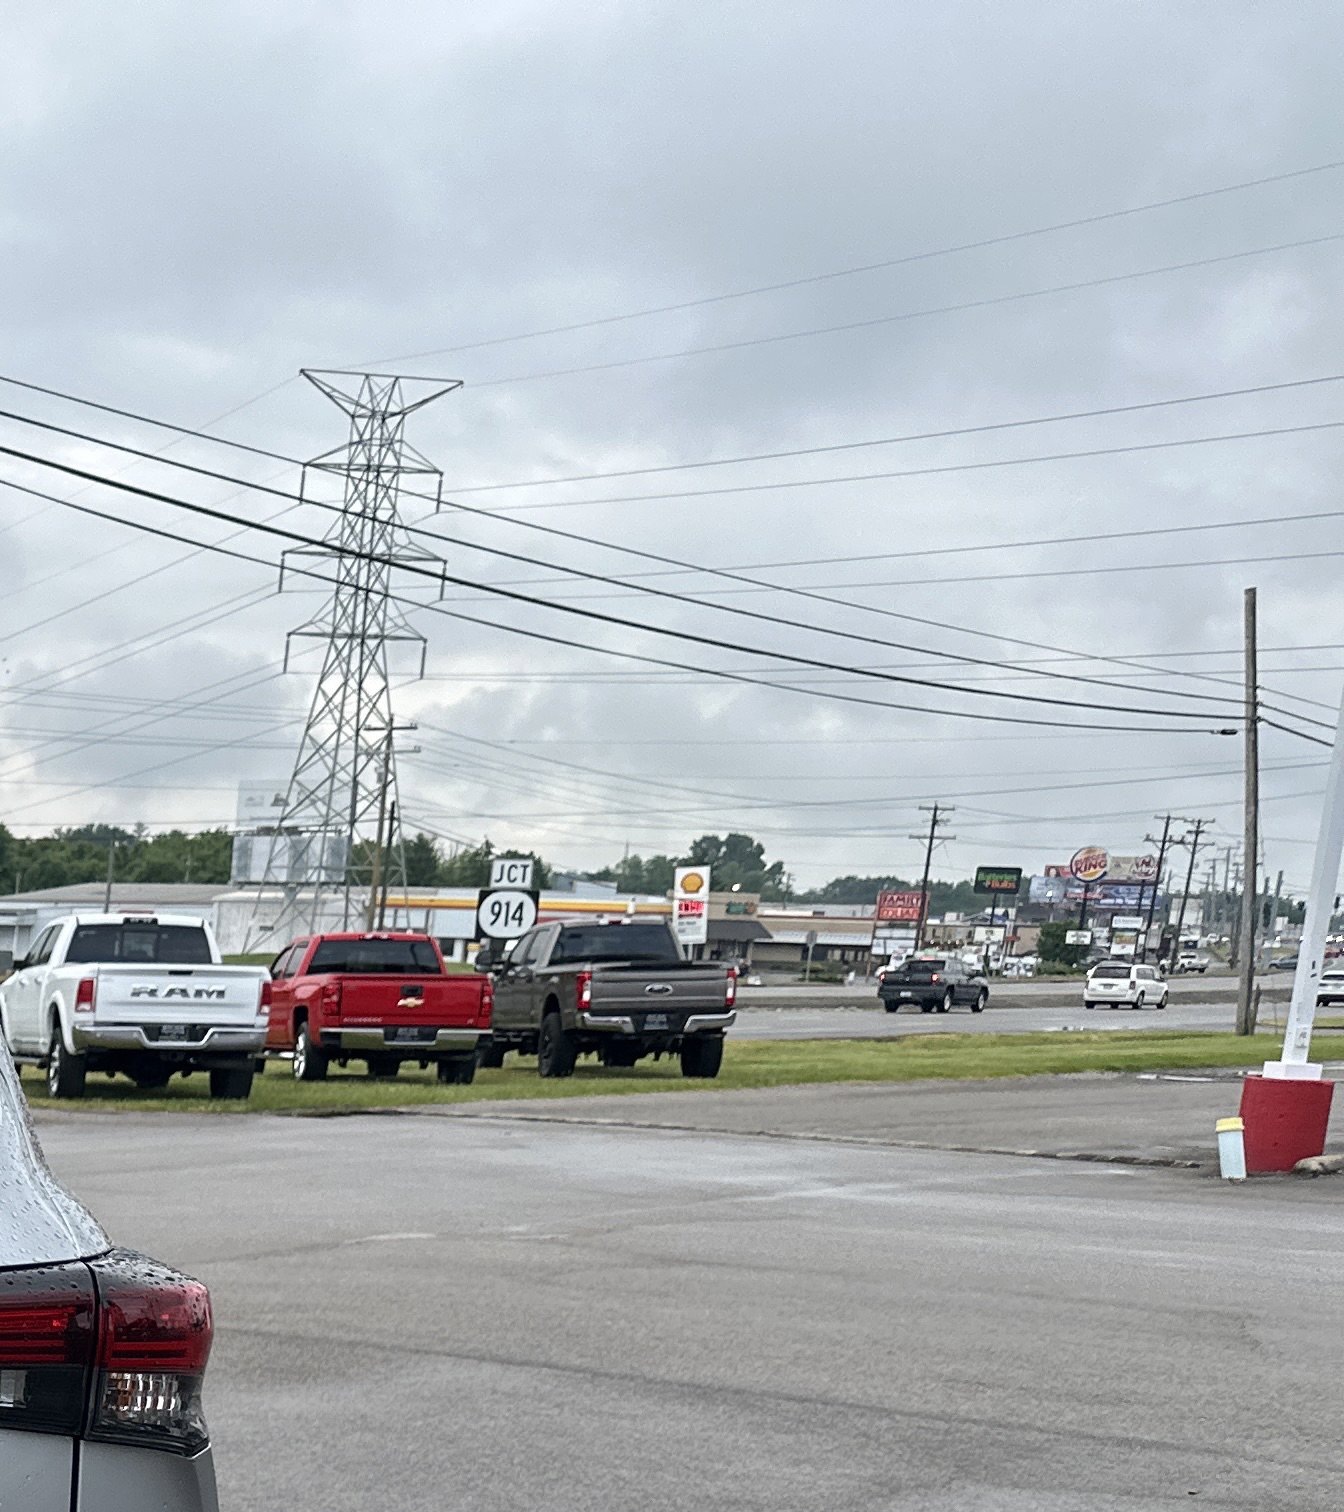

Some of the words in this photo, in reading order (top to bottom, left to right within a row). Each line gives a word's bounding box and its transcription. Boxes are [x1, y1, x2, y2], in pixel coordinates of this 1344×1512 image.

[494, 863, 529, 884] JCT
[1074, 859, 1107, 873] KING
[489, 901, 524, 928] 914
[131, 985, 226, 999] RAM
